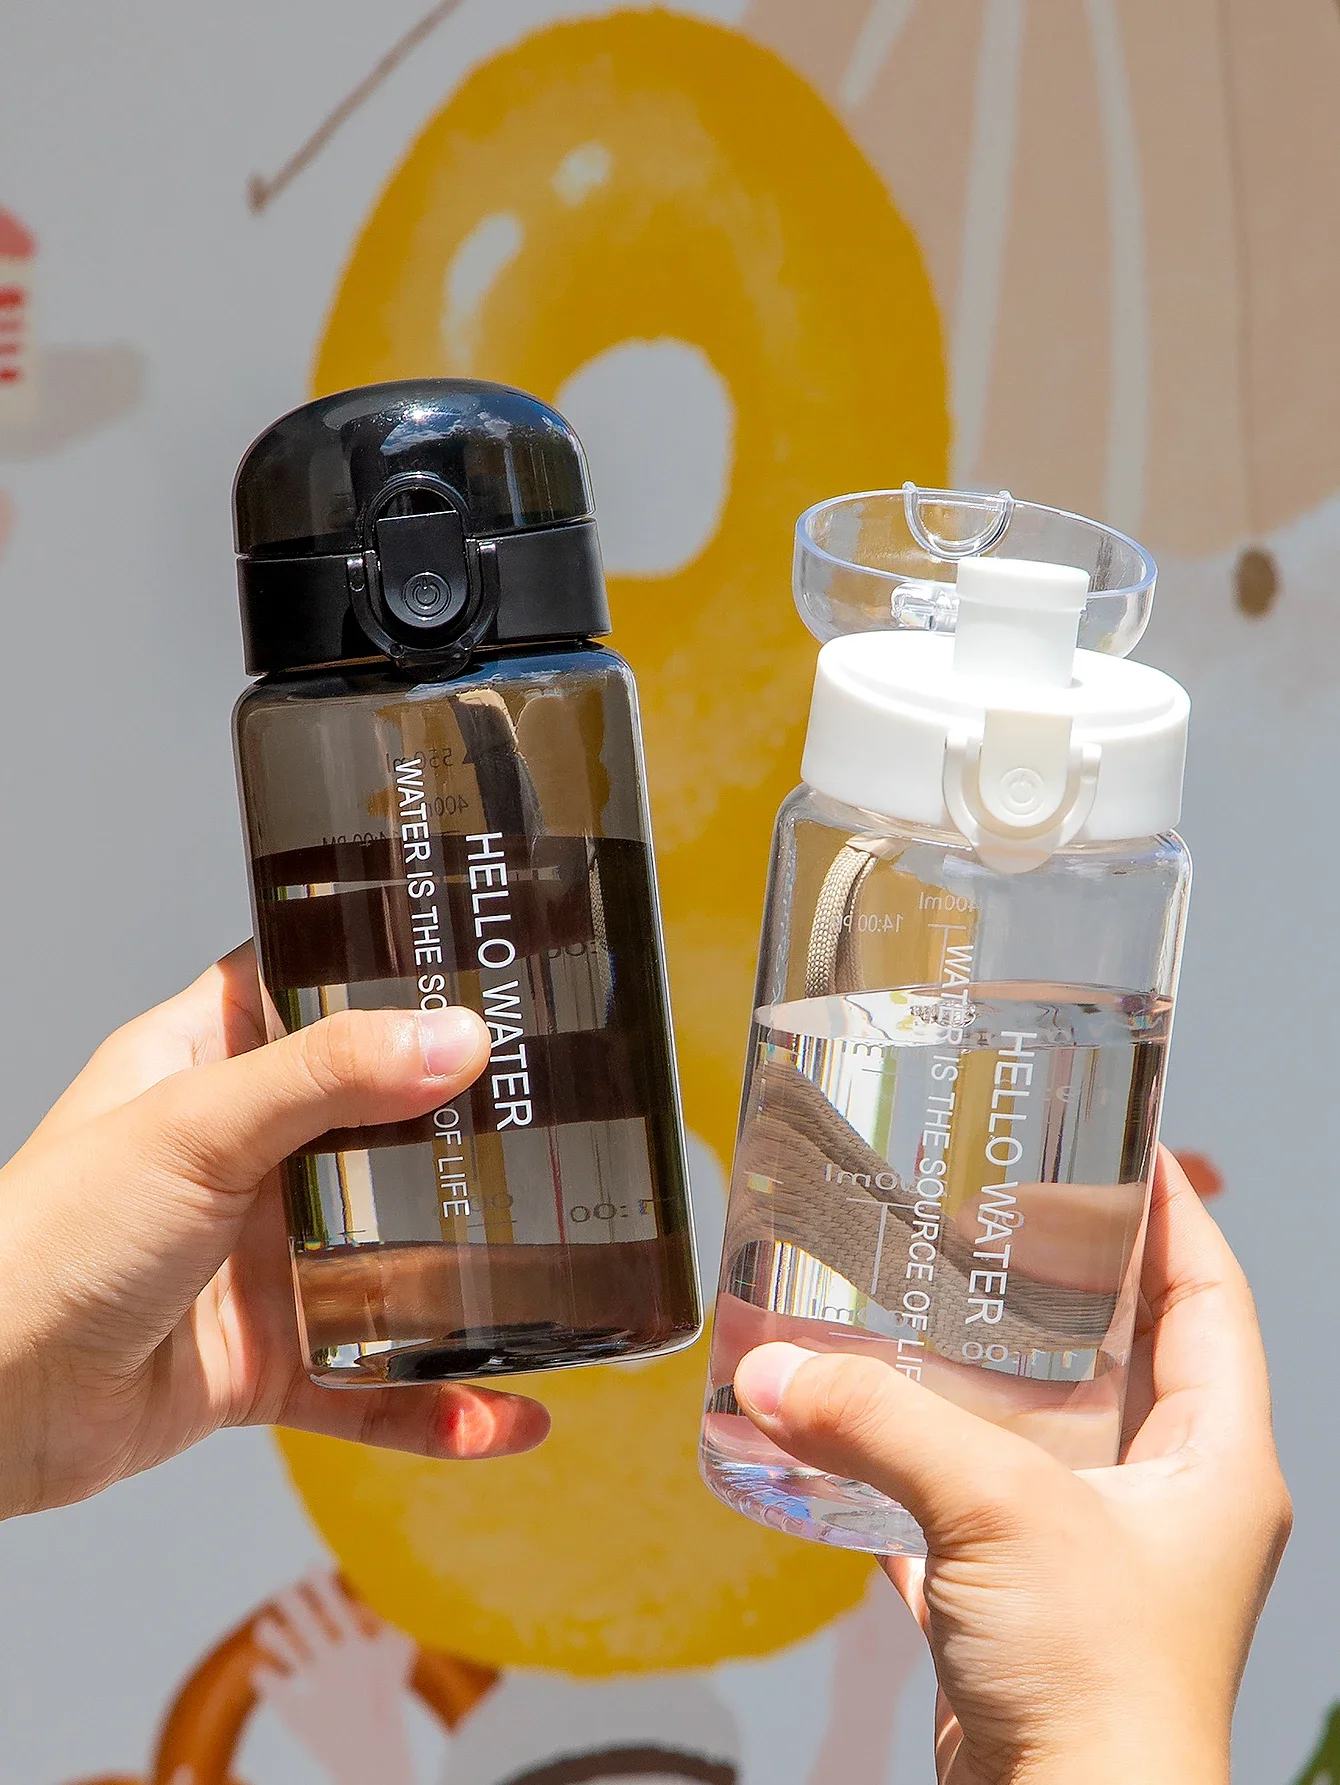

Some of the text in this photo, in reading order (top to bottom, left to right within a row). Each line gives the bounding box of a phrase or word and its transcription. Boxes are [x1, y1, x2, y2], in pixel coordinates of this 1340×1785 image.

[395, 757, 432, 864] WATER
[406, 871, 436, 899] IS
[411, 905, 443, 966] THE
[465, 831, 516, 969] HELLO
[482, 980, 533, 1132] WATER
[985, 1031, 1037, 1166] HELLO
[433, 1107, 471, 1218] OF LIFE
[896, 945, 975, 1382] WATER IS THE SOURCE OF LIF
[965, 1181, 1019, 1325] WATER
